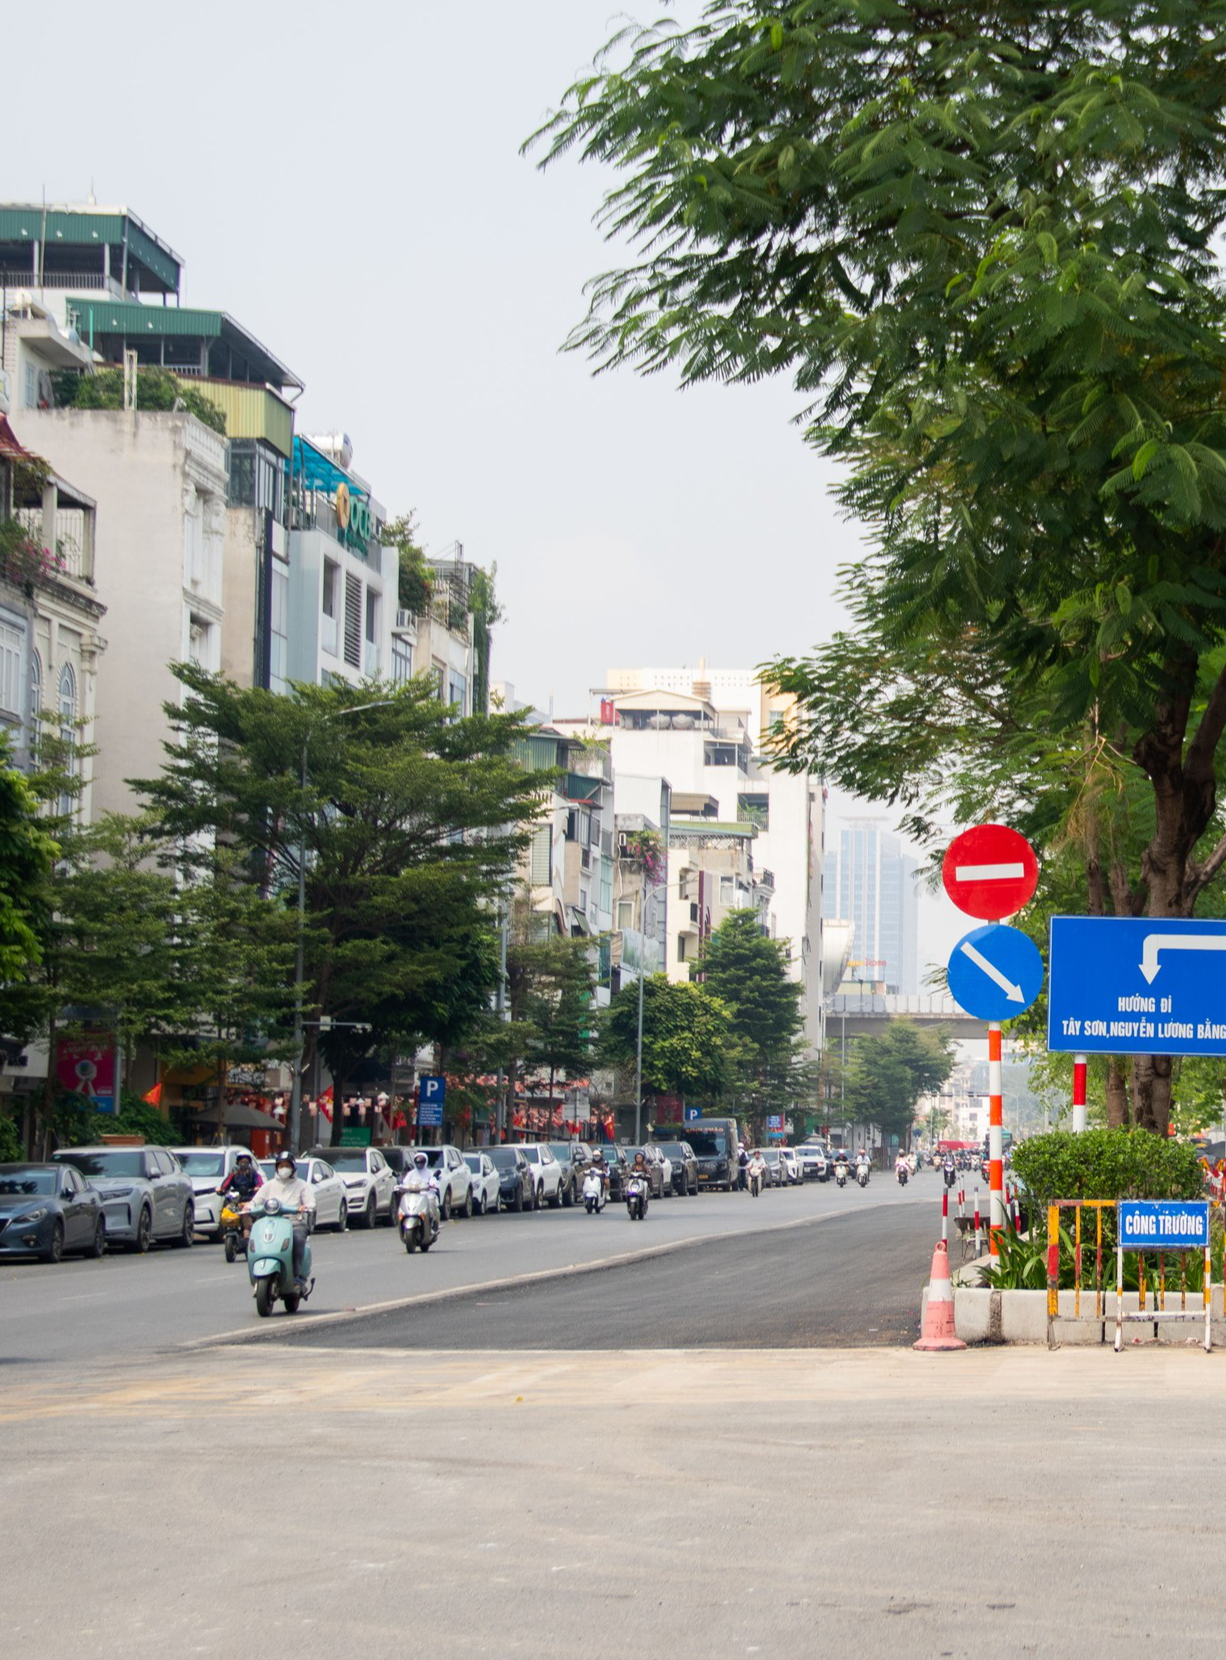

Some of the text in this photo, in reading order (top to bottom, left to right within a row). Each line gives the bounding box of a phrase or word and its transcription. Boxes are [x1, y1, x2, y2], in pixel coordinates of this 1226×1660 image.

[1118, 993, 1156, 1013] HƯỚNG
[1062, 1016, 1081, 1036] TÂY
[1197, 1018, 1226, 1039] BẰNG
[427, 1080, 439, 1097] P
[690, 1109, 698, 1120] P
[1125, 1210, 1203, 1235] CÔNG TRƯỜNG
